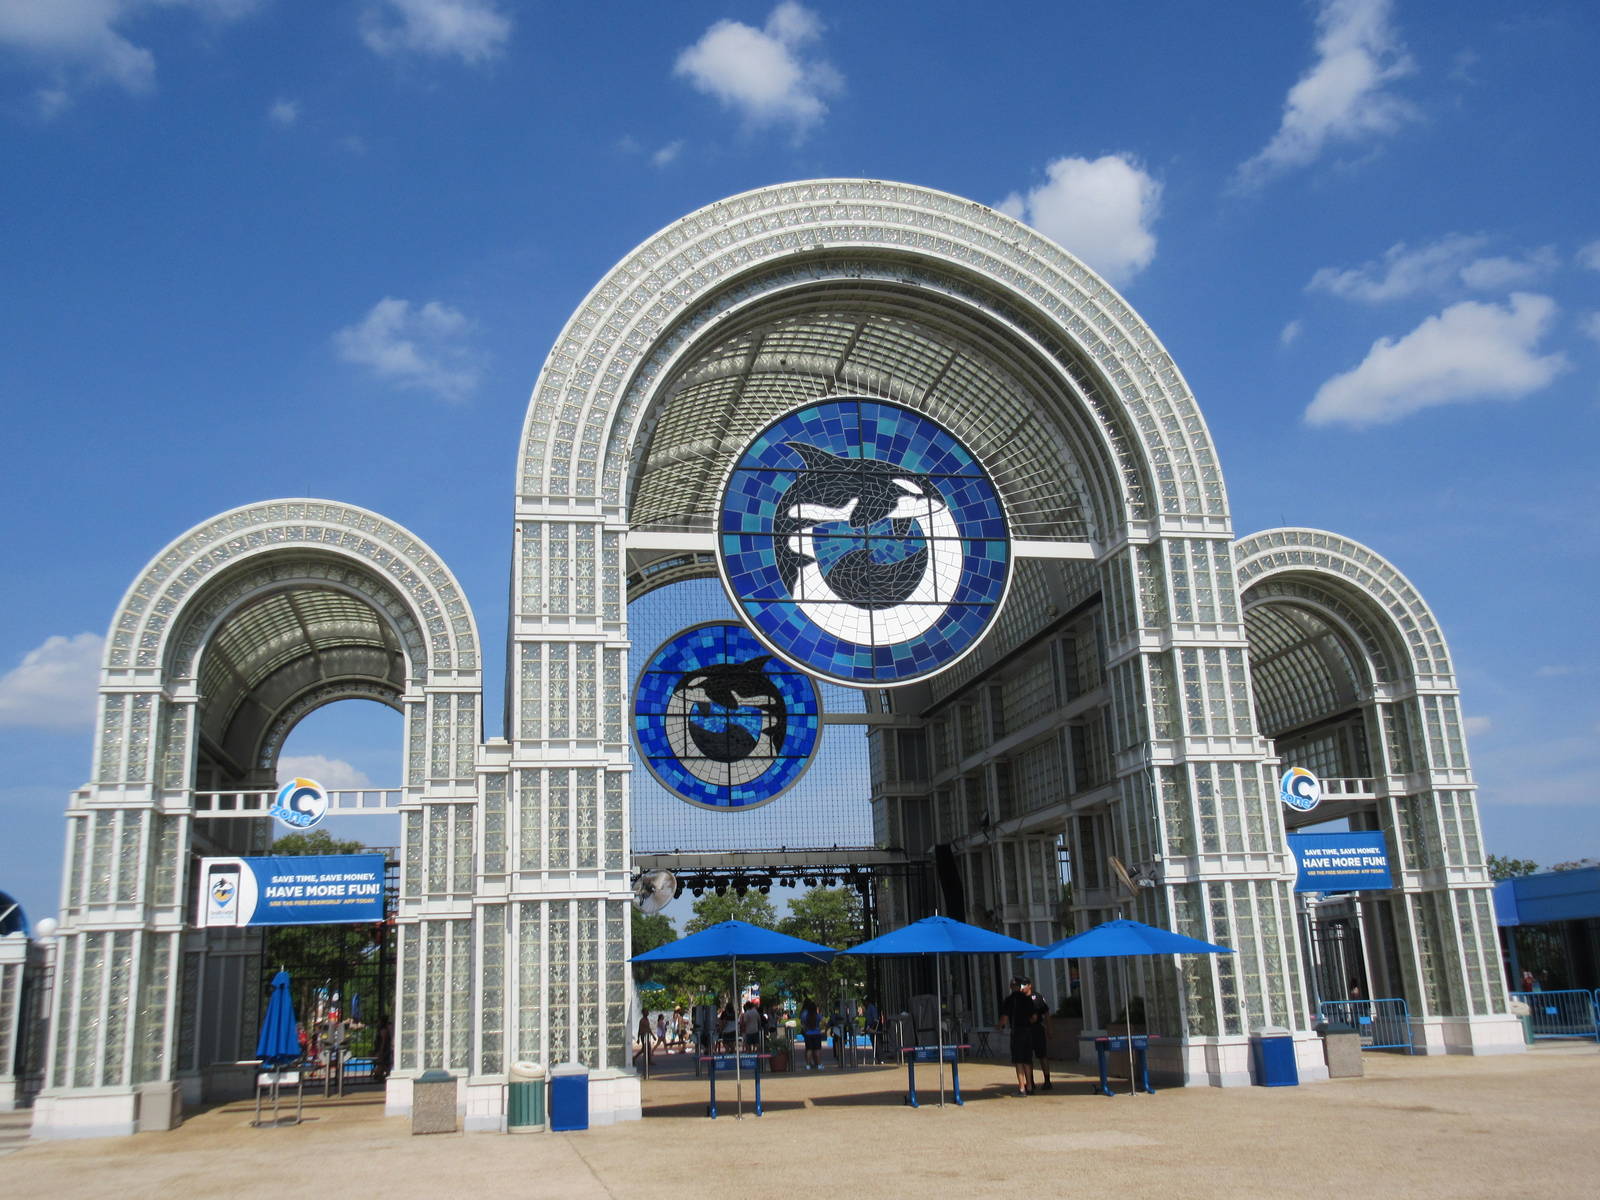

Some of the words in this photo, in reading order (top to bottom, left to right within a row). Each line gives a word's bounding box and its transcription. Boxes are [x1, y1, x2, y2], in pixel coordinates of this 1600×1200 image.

[1280, 791, 1311, 808] zone
[269, 804, 313, 827] zone
[1304, 848, 1321, 856] SAVE
[1302, 857, 1330, 868] HAVE
[1331, 857, 1361, 867] MORE
[1362, 856, 1386, 866] FUN!
[272, 875, 294, 884] SAVE
[296, 874, 318, 883] TIME,
[319, 874, 342, 882] SAVE
[343, 873, 375, 881] MONEY.
[266, 886, 303, 898] HAVE
[305, 885, 345, 896] MORE
[348, 884, 380, 895] FUN!
